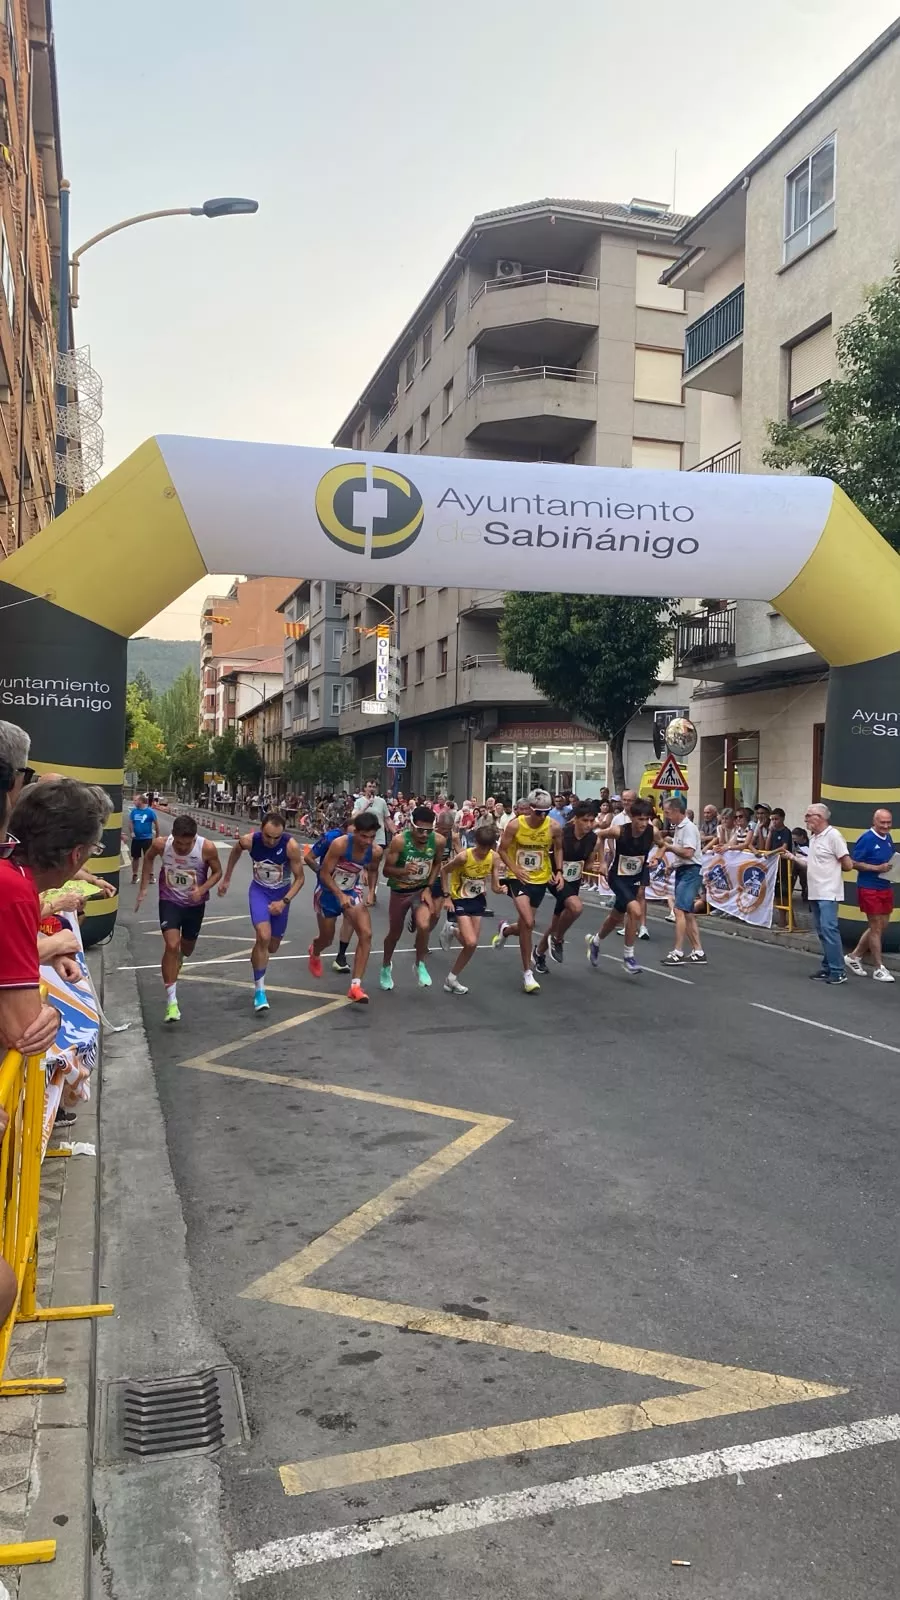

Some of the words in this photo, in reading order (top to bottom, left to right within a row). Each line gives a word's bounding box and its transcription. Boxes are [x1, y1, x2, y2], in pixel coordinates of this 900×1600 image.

[436, 487, 694, 523] Ayuntamiento
[377, 639, 388, 700] OLIMPIC
[0, 692, 112, 712] Sabiñánigo
[852, 709, 900, 723] Ayun
[524, 728, 552, 740] REGALO
[524, 857, 536, 866] 84
[341, 877, 349, 885] 2
